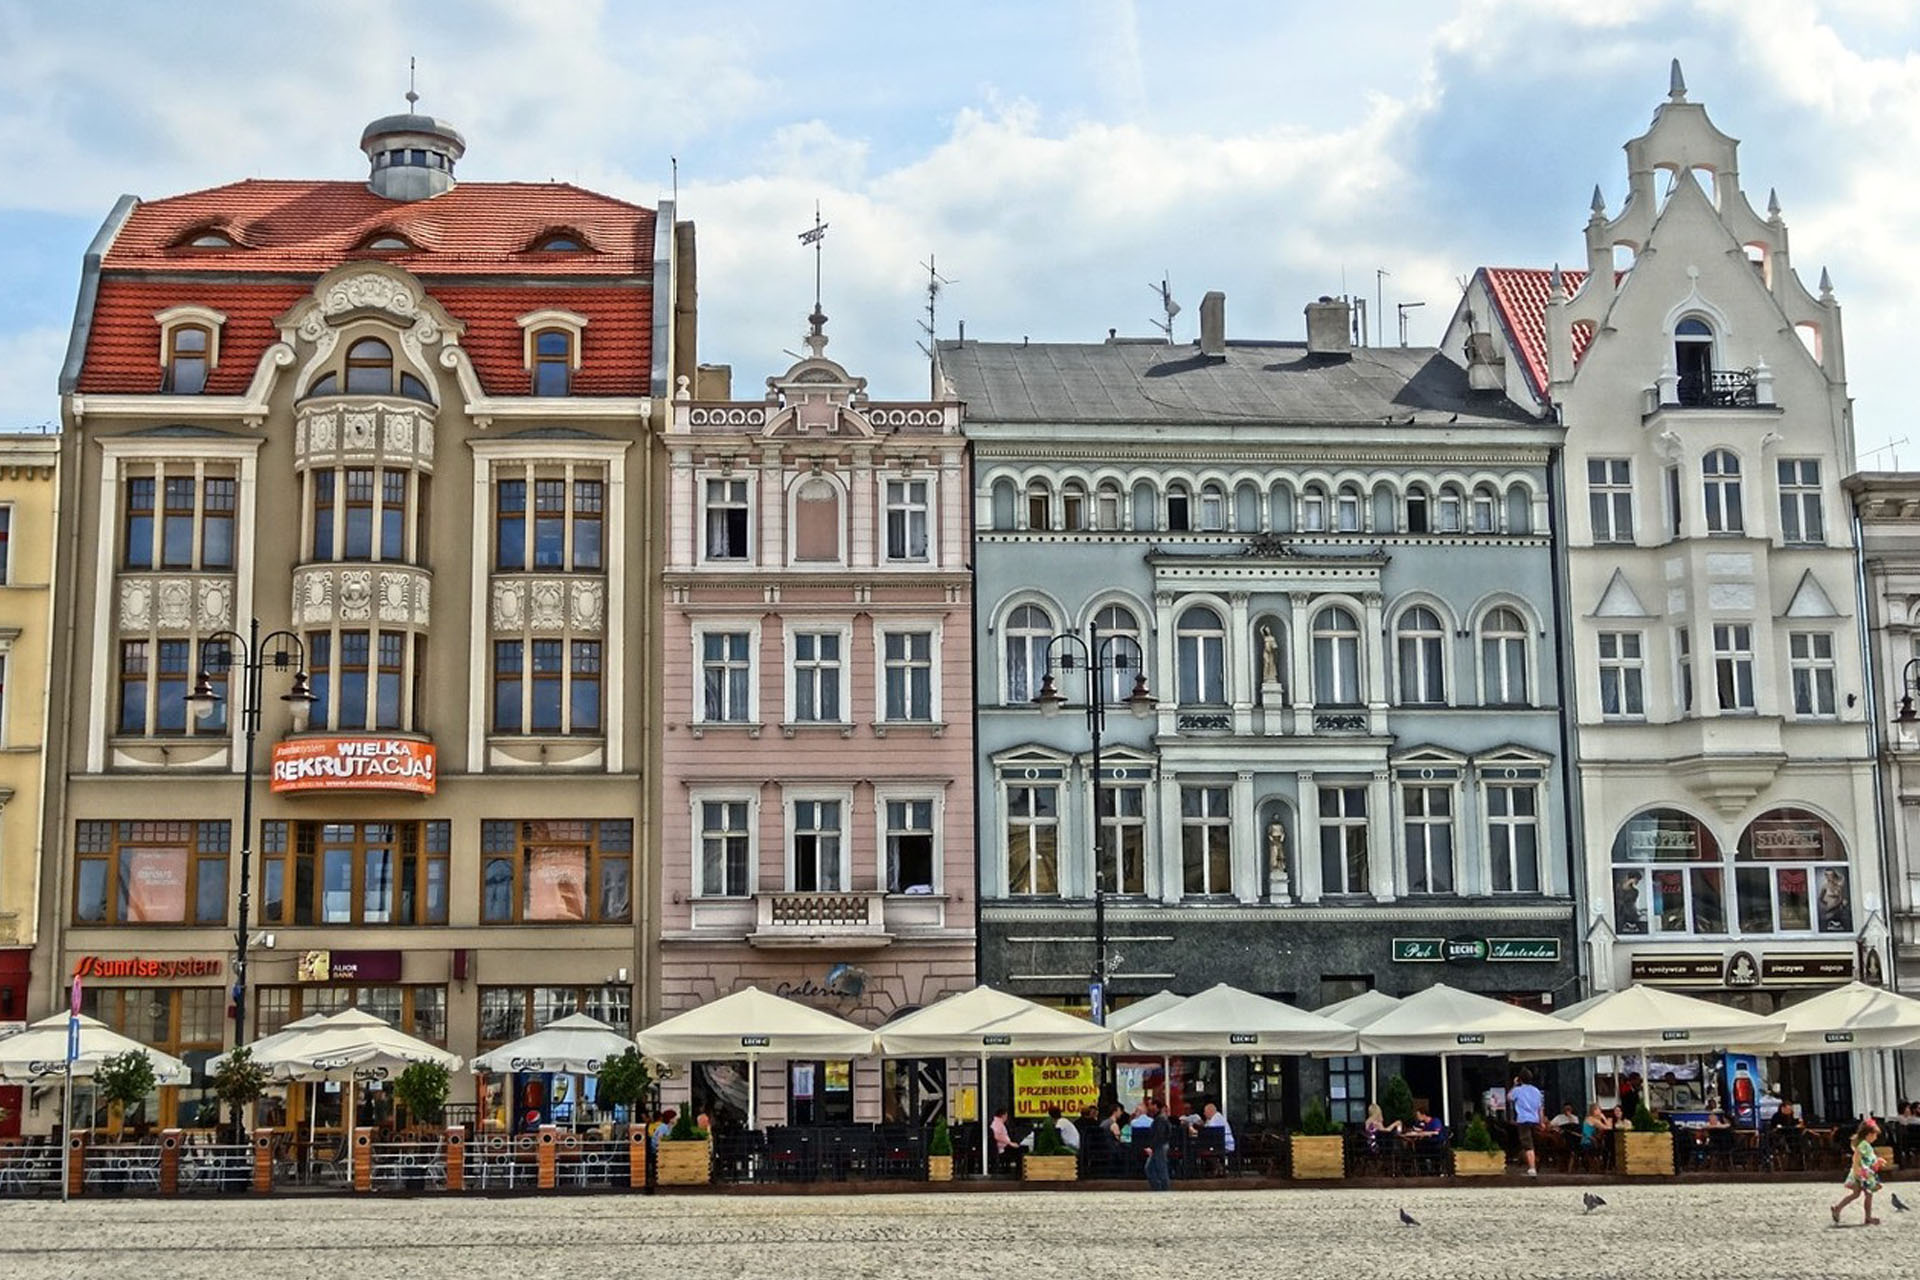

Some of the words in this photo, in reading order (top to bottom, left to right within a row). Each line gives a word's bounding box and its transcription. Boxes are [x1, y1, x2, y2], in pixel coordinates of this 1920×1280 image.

[337, 741, 411, 756] WIELKA
[274, 755, 433, 780] REKRUTACJA!
[1403, 942, 1432, 958] Pub
[1450, 943, 1473, 954] LECH
[1492, 943, 1556, 958] Amsterdam
[333, 964, 358, 972] ALIOR
[510, 1057, 544, 1072] Carlsberg
[1042, 1069, 1080, 1080] SKLEP
